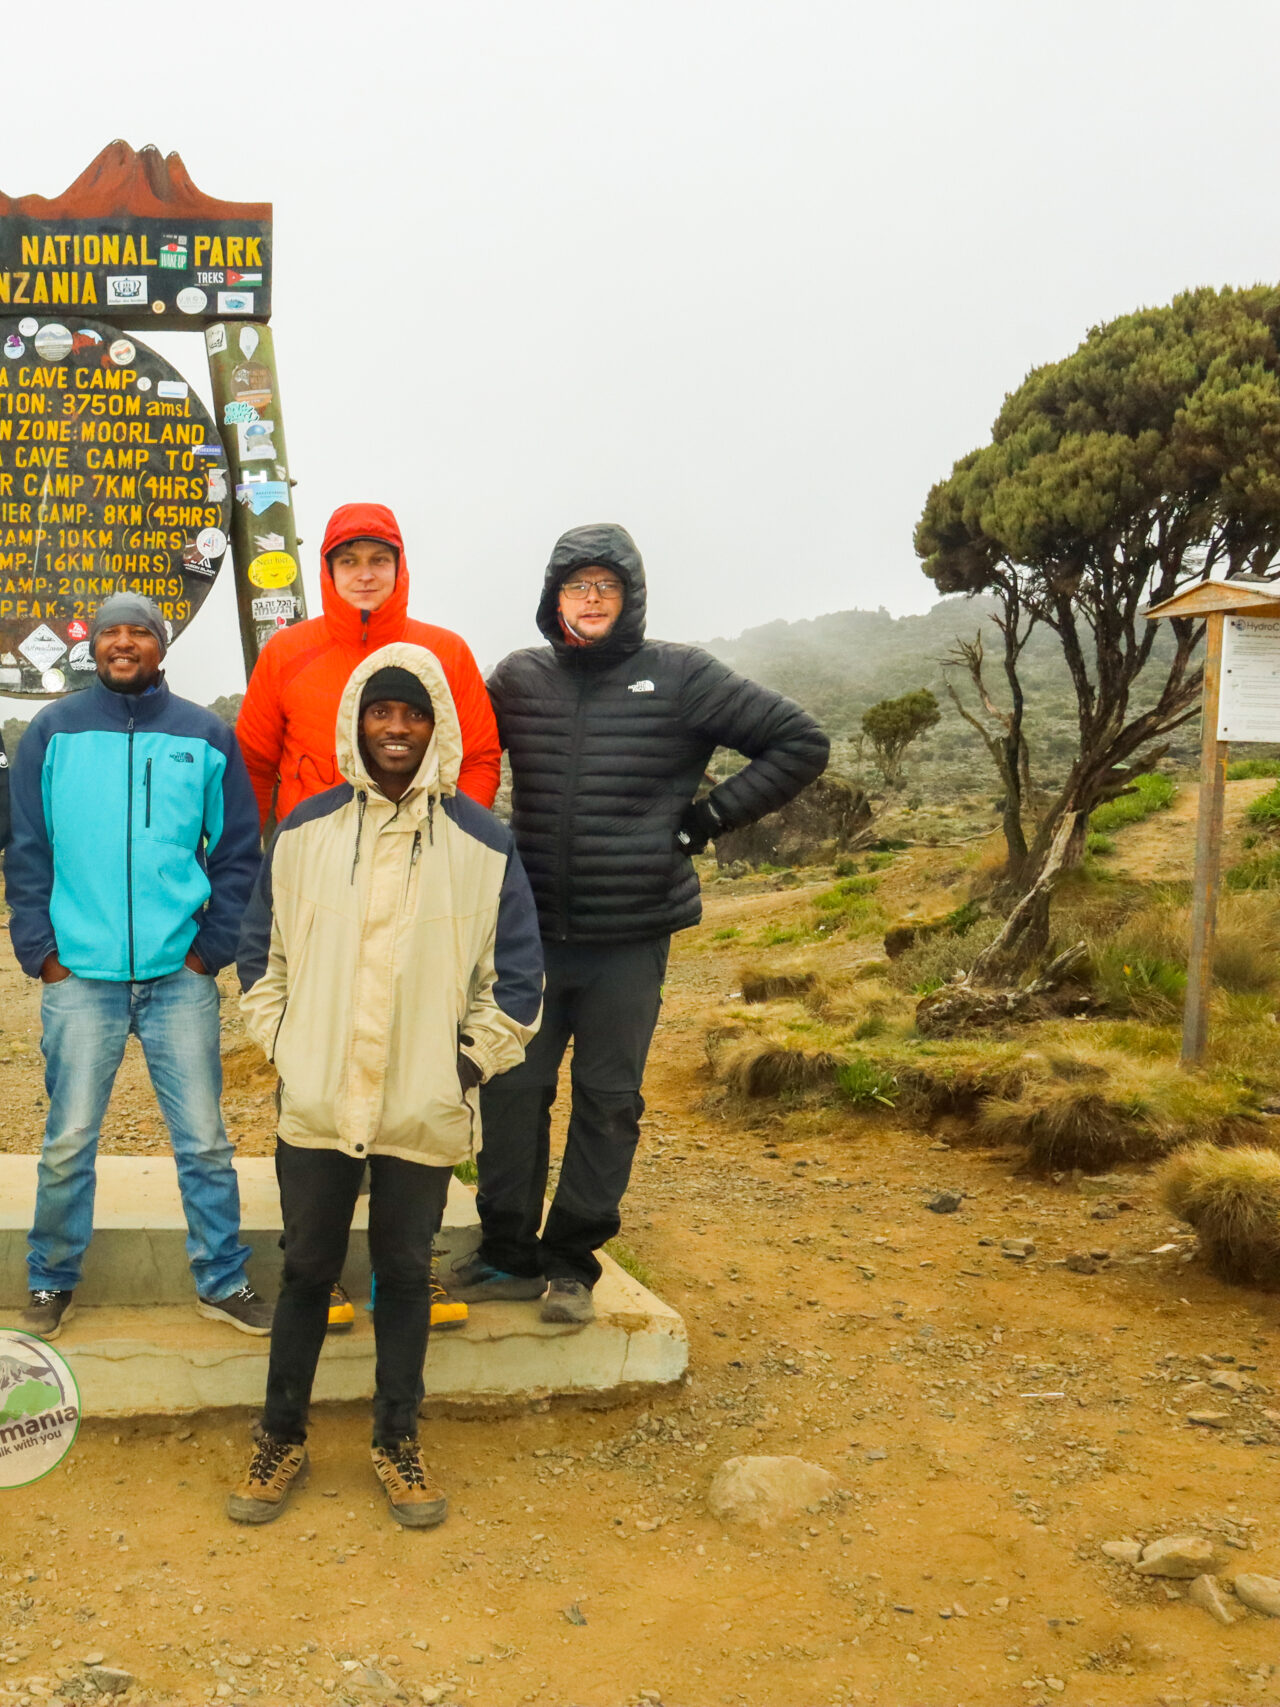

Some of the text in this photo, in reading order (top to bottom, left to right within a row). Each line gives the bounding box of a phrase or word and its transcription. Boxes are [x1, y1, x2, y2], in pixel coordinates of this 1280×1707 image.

[22, 235, 157, 266] NATIONAL
[195, 236, 262, 267] PARK
[197, 271, 224, 284] TREKS
[19, 367, 69, 390] CAVE
[75, 368, 138, 391] CAMP
[62, 394, 141, 416] 3750M
[145, 398, 191, 418] amsl
[81, 421, 205, 446] MOORLAND
[15, 447, 69, 468] CAVE
[86, 448, 149, 470] CAMP
[24, 474, 84, 498] CAMP
[92, 474, 135, 499] 7KM
[38, 503, 93, 524] CAMP:
[104, 504, 142, 525] 8KM
[59, 529, 112, 549] 10KM
[45, 553, 94, 572] 16KM
[100, 551, 171, 578] (10HRS)
[58, 578, 114, 595] 20KM
[116, 575, 184, 600] (14HRS)
[73, 601, 104, 620] 25
